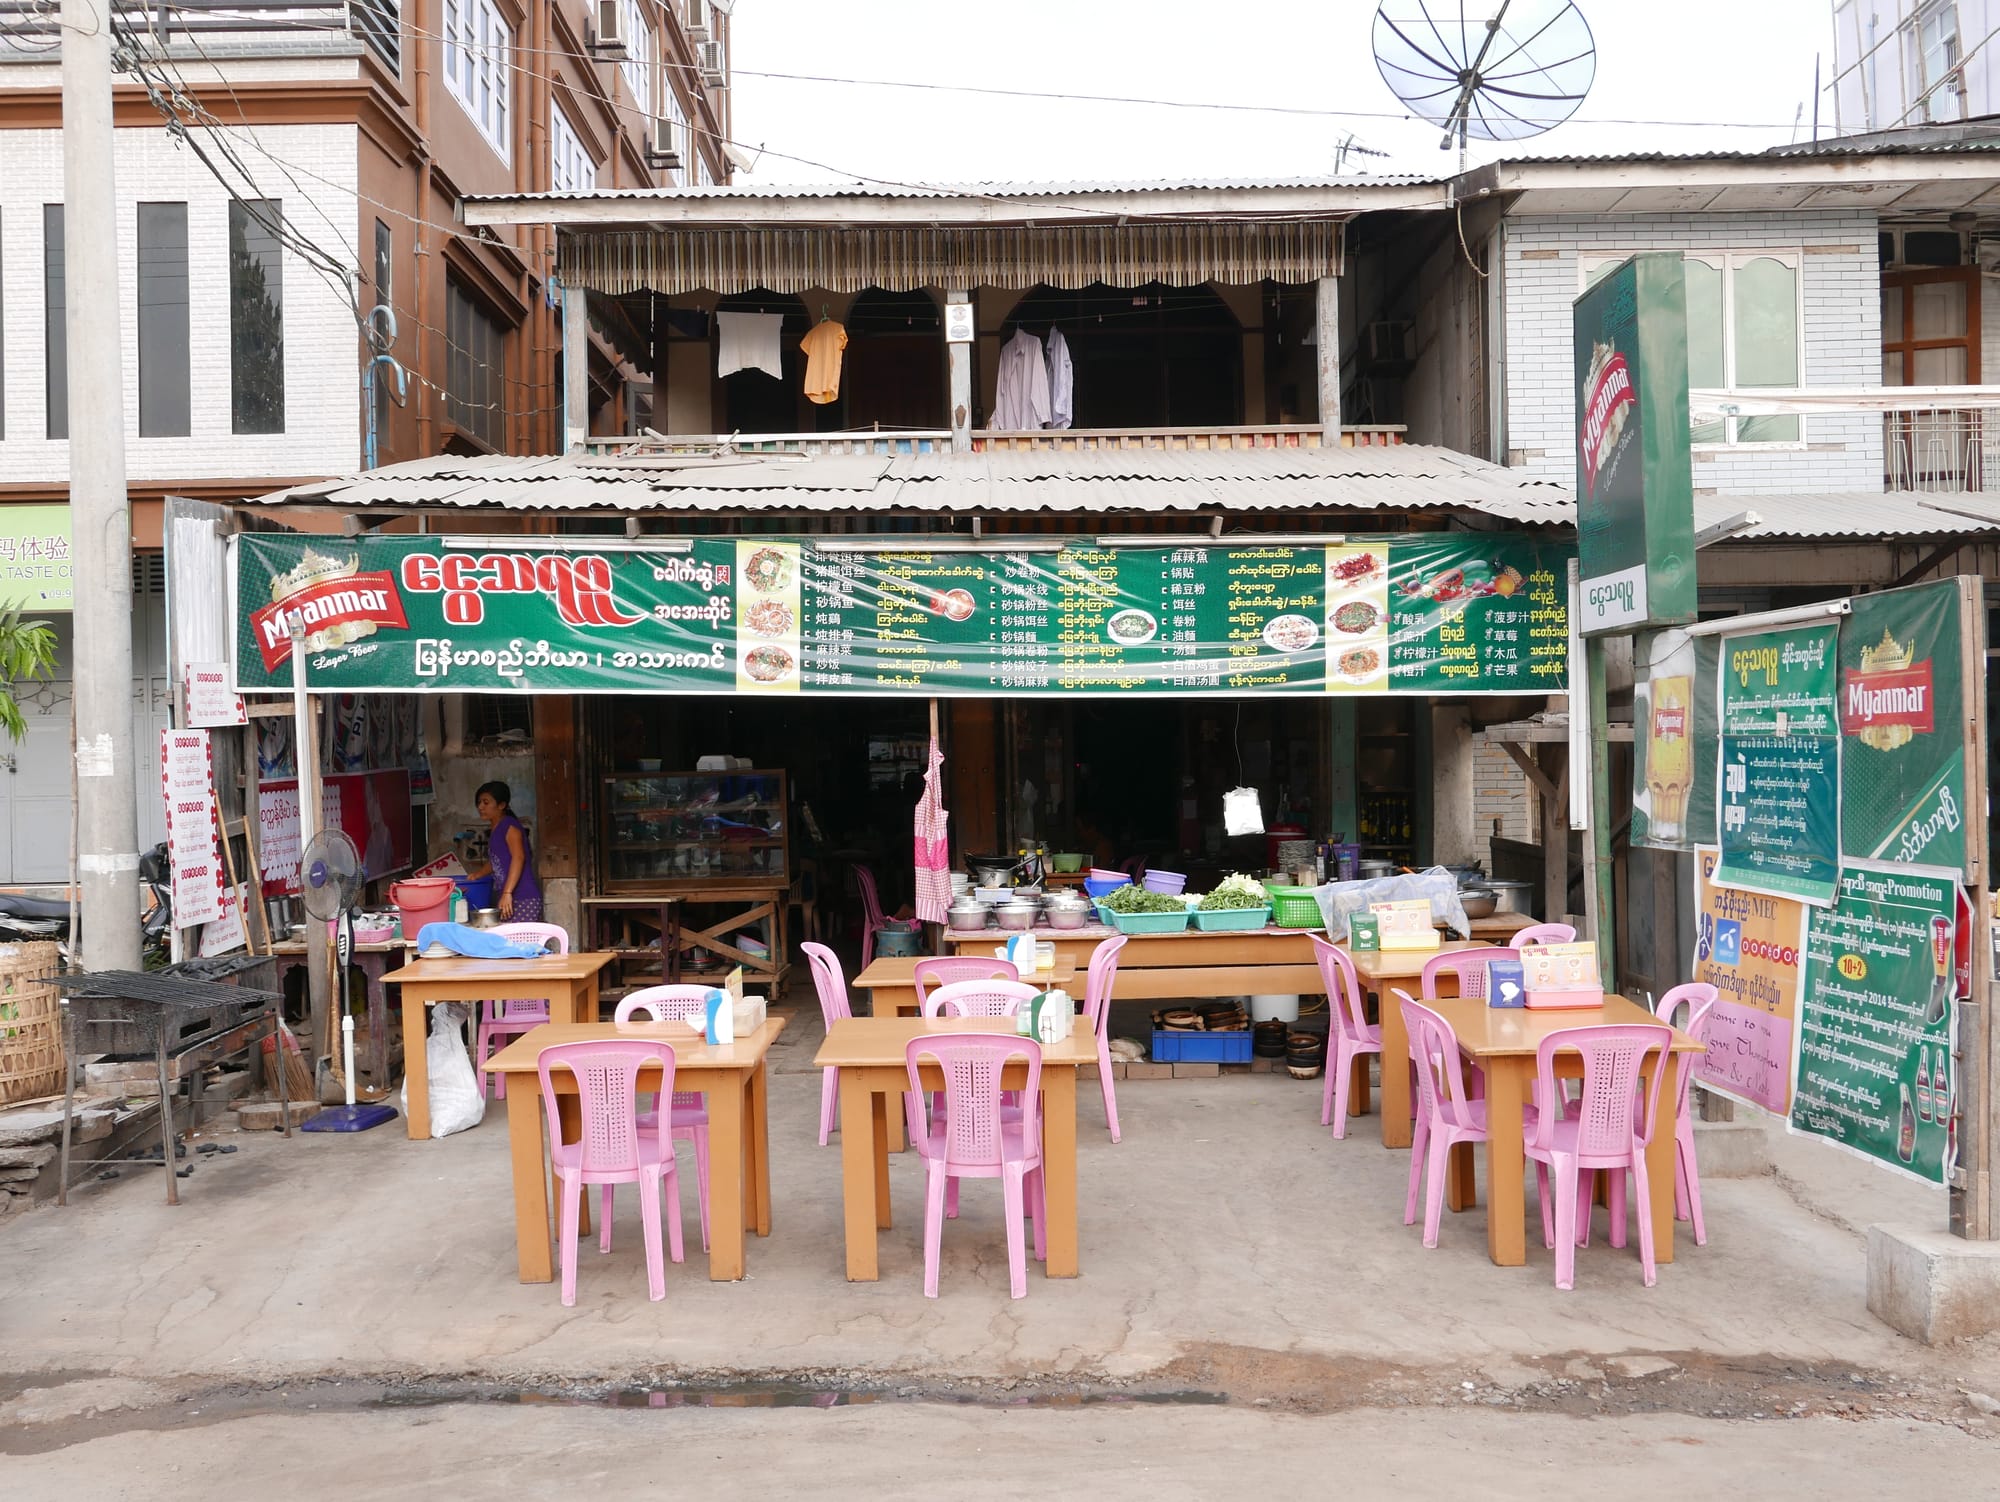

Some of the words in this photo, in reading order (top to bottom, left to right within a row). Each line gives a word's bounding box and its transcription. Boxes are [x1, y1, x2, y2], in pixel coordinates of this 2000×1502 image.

[1583, 366, 1630, 469] Myanmar
[0, 536, 70, 562] 玛体验
[6, 565, 53, 579] TASTE
[653, 557, 713, 592] ခေါက်ဆွဲ
[1001, 583, 1048, 595] 砂锅米线
[1171, 583, 1206, 595] 稀豆粉
[815, 596, 854, 608] 砂锅鱼
[1001, 599, 1048, 611] 砂锅粉丝
[654, 596, 731, 629] အအေးဆိုင်
[1172, 615, 1196, 627] 卷粉
[1494, 630, 1518, 642] 草莓
[816, 643, 852, 655] 麻辣菜
[1402, 647, 1438, 659] 柠檬汁
[1494, 647, 1518, 660] 木瓜
[312, 653, 349, 671] Lager
[348, 643, 378, 659] Beer
[414, 637, 588, 678] မြန်မာစည်ဘီယာ
[613, 642, 725, 669] အသားကင်
[1494, 664, 1518, 677] 芒果
[1001, 676, 1048, 688] 砂锅麻辣
[1848, 682, 1927, 722] Myanmar
[1843, 957, 1863, 978] 10+2
[1869, 992, 1887, 1007] 2014
